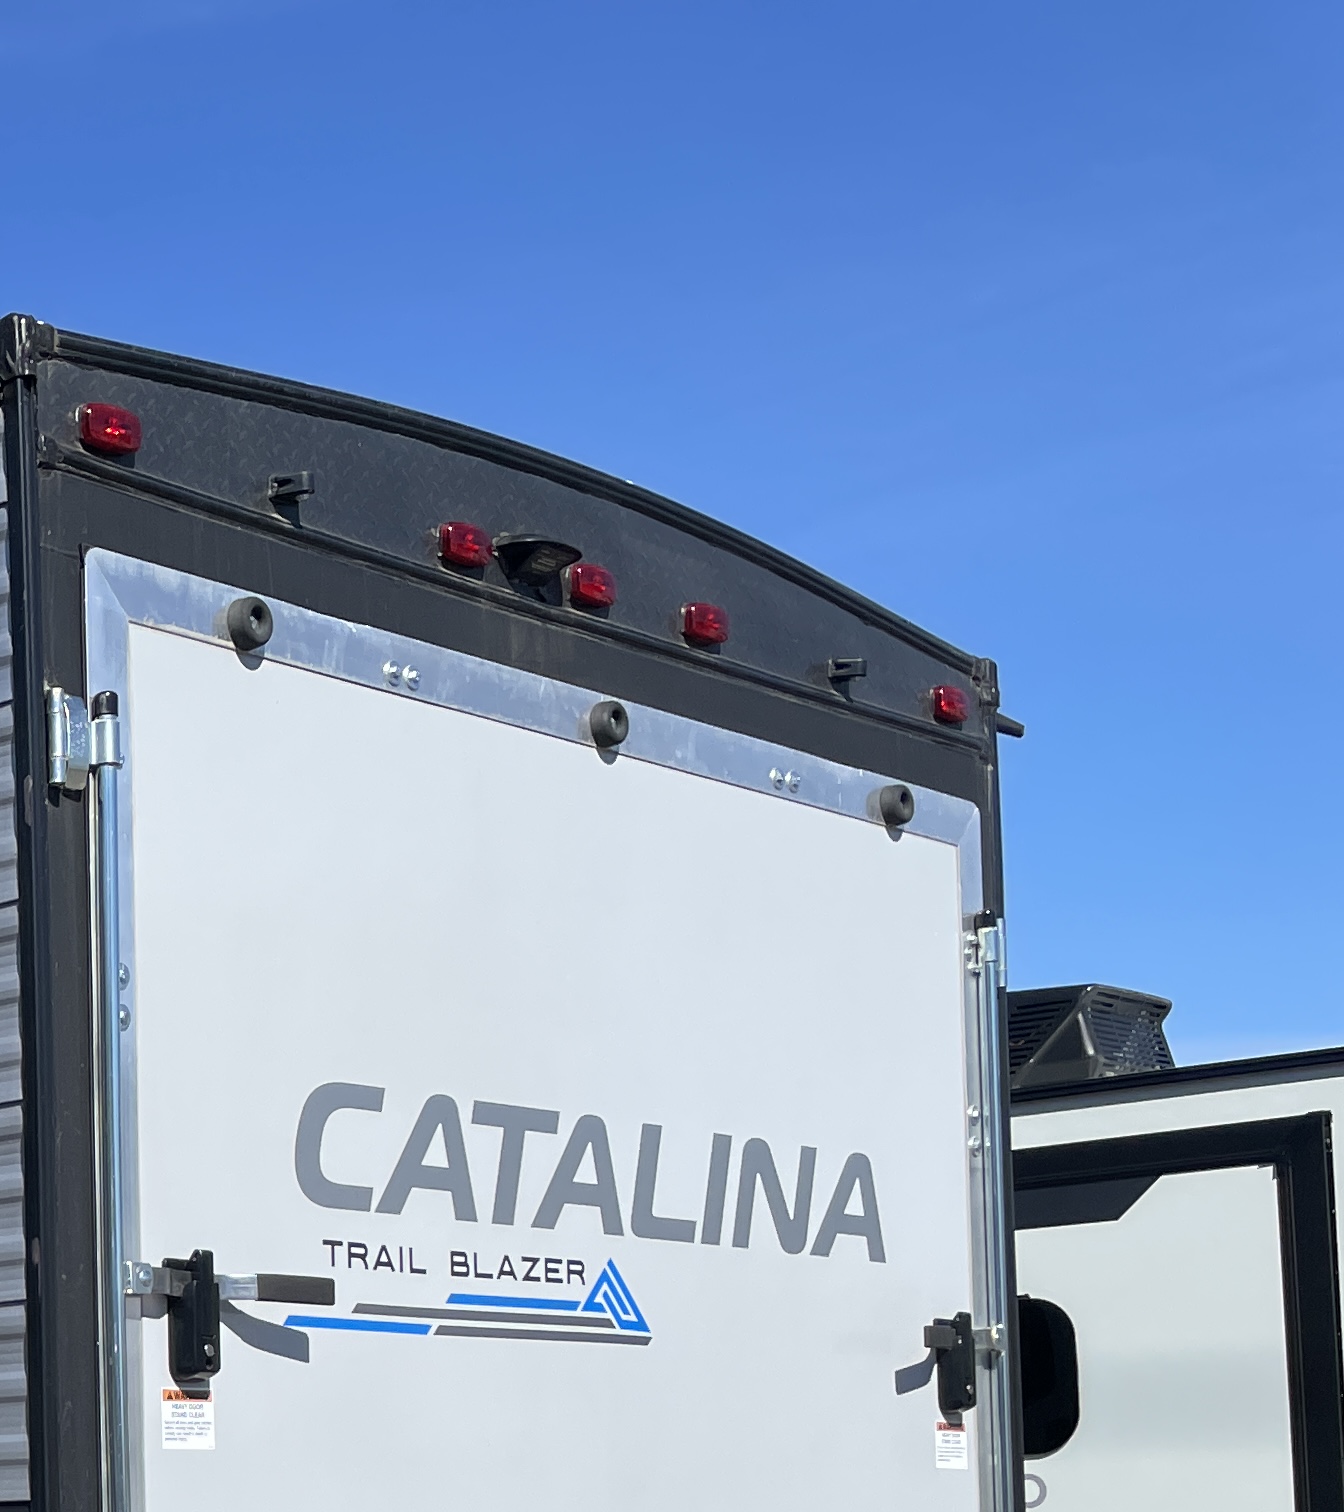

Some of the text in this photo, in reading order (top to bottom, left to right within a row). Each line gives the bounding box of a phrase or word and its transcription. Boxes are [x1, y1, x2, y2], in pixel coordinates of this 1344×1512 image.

[294, 1081, 887, 1264] CATALINA
[321, 1239, 587, 1287] TRAIL BLAZER
